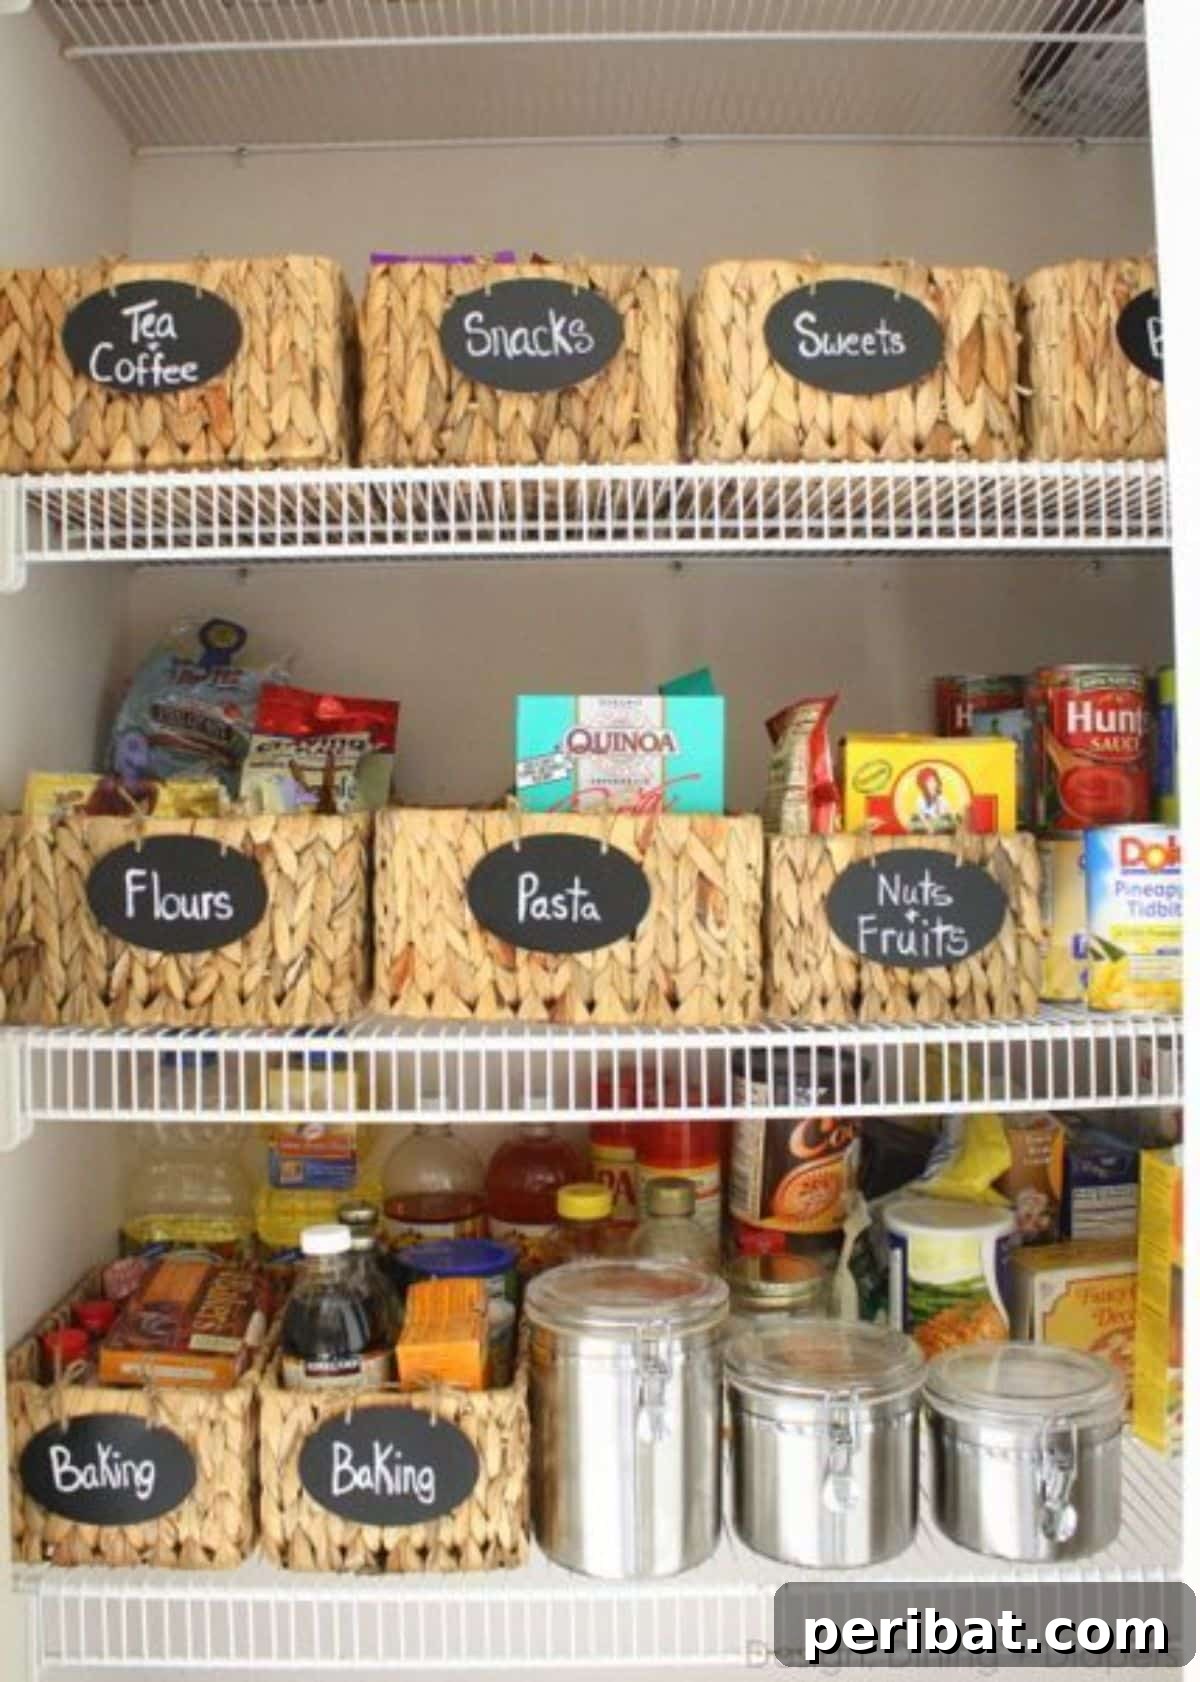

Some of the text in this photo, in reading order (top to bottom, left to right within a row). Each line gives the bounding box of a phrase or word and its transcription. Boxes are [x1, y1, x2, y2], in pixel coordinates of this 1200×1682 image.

[121, 299, 177, 343] Tea
[464, 308, 595, 358] Snacks
[793, 311, 906, 358] Sweets
[1146, 315, 1163, 357] B
[89, 341, 199, 387] Coffee
[1067, 700, 1143, 736] Hun
[566, 728, 676, 755] QUINOA
[125, 868, 234, 920] Flours
[517, 871, 601, 924] Pasta
[876, 868, 954, 907] Nuts
[1115, 881, 1184, 904] Pineap
[857, 914, 969, 957] Fruits
